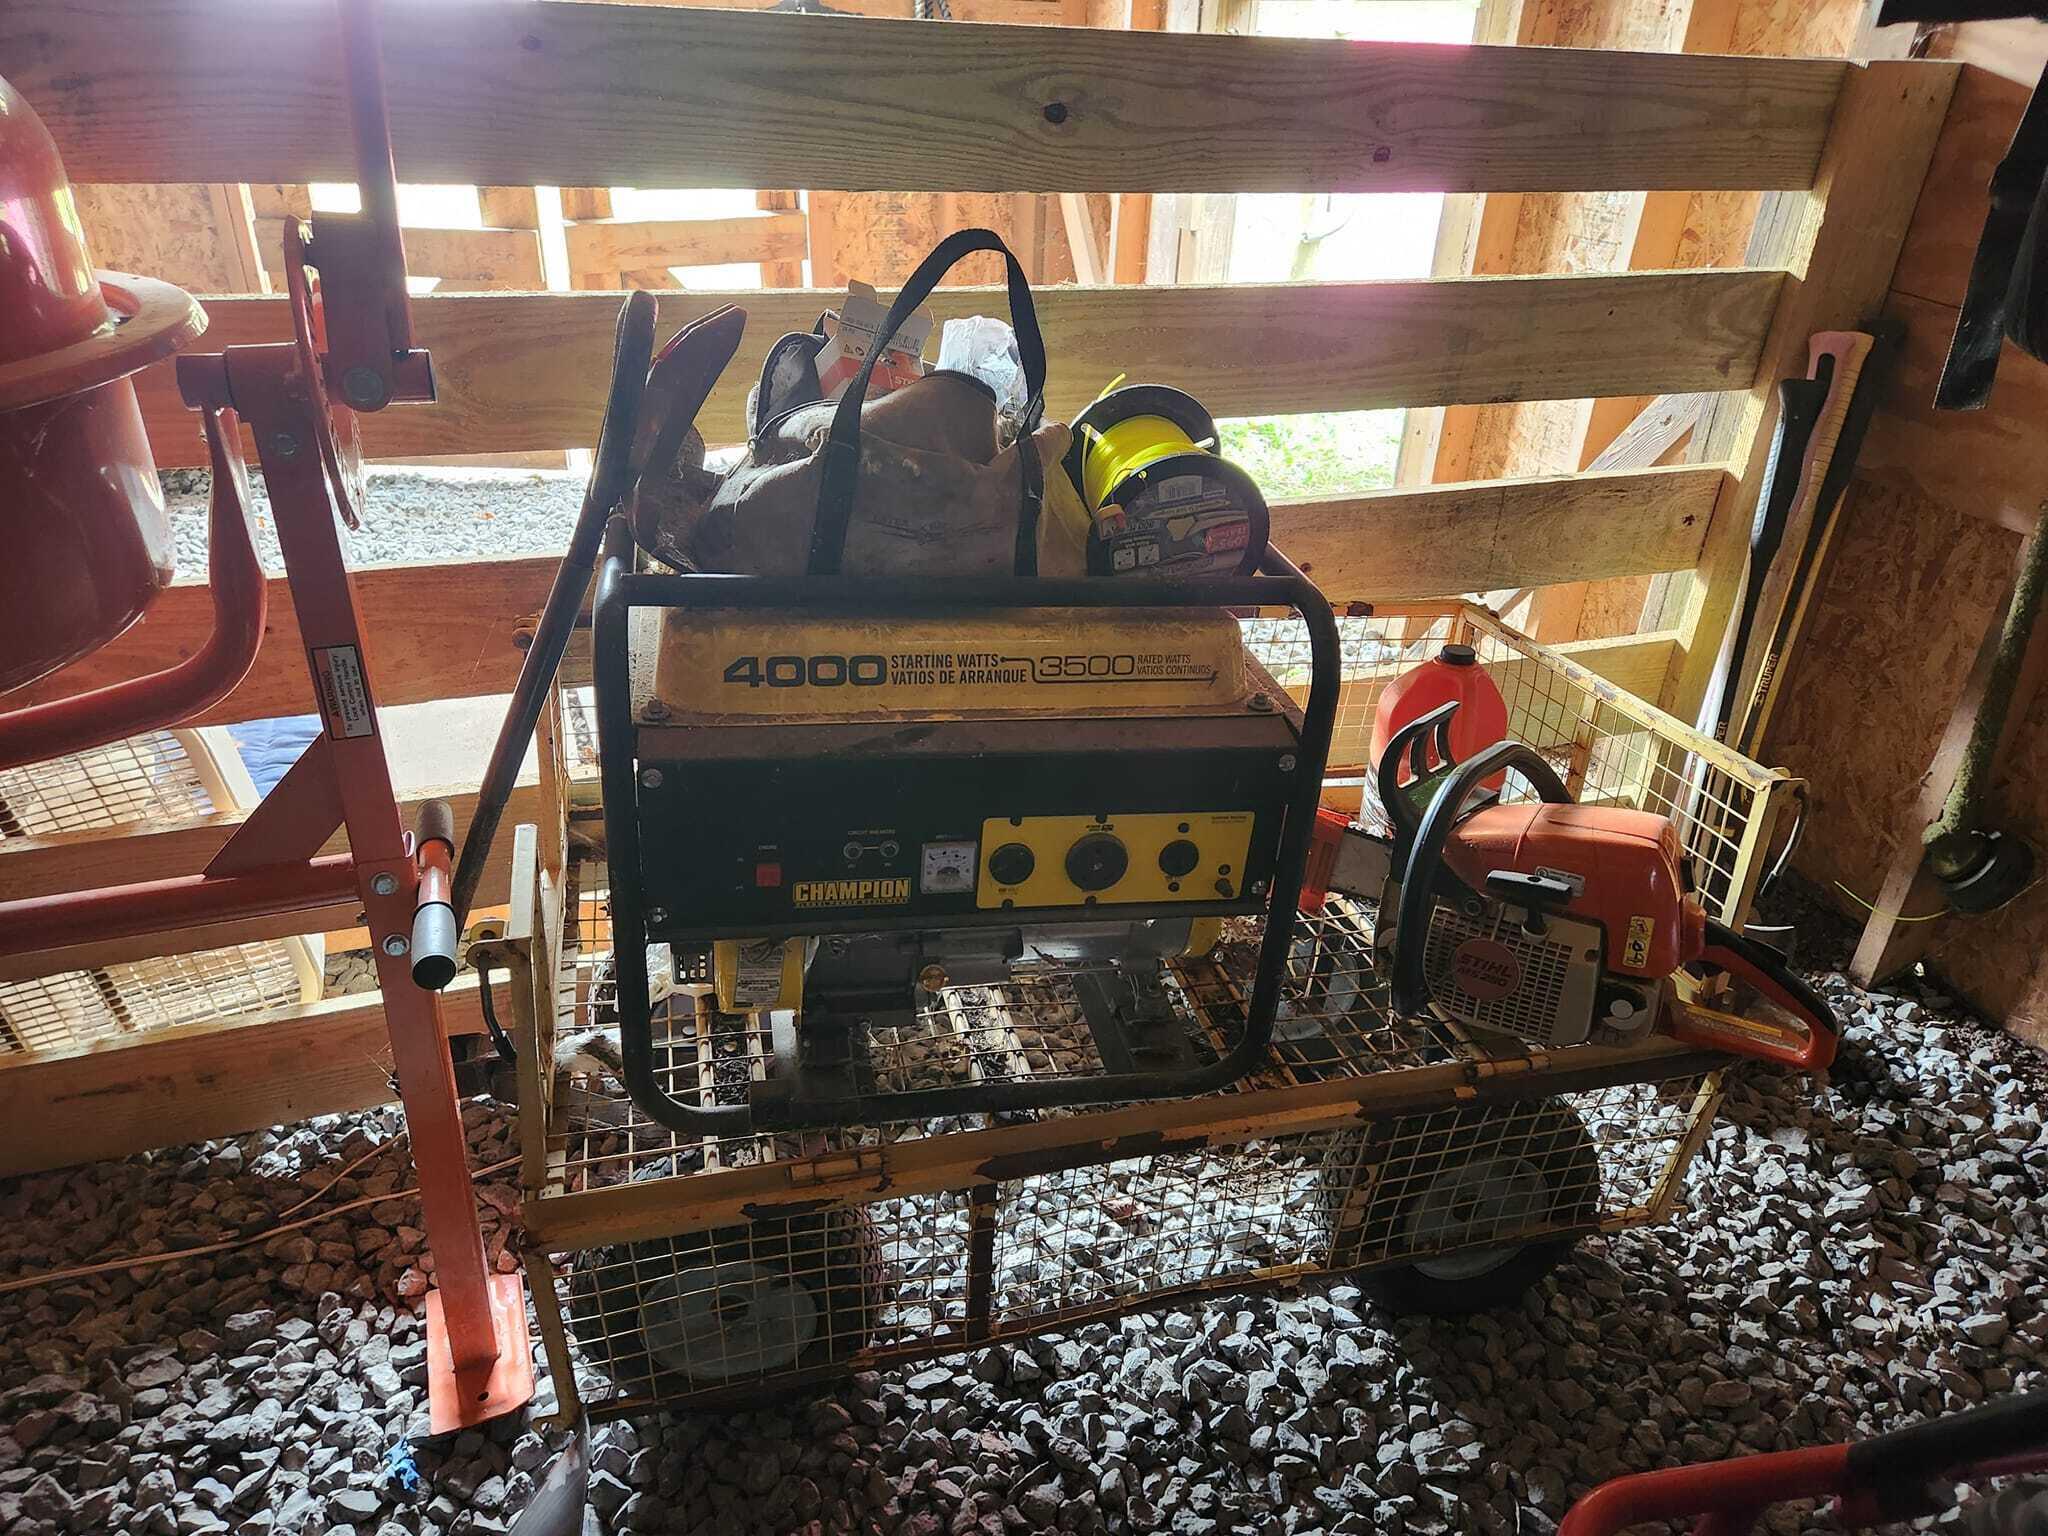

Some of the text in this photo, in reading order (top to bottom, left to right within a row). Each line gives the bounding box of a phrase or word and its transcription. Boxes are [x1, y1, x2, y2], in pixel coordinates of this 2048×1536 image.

[891, 654, 998, 669] STARTING WATTS
[1039, 655, 1135, 677] 3500
[1137, 654, 1191, 664] RATED WATTS
[723, 655, 888, 688] 4000
[891, 669, 1027, 685] VATIOS DE ARRANQUE
[1137, 665, 1164, 676] VATIOS
[1758, 653, 1779, 693] TRUPER
[795, 879, 909, 901] CHAMPION
[1459, 952, 1513, 978] STIHL
